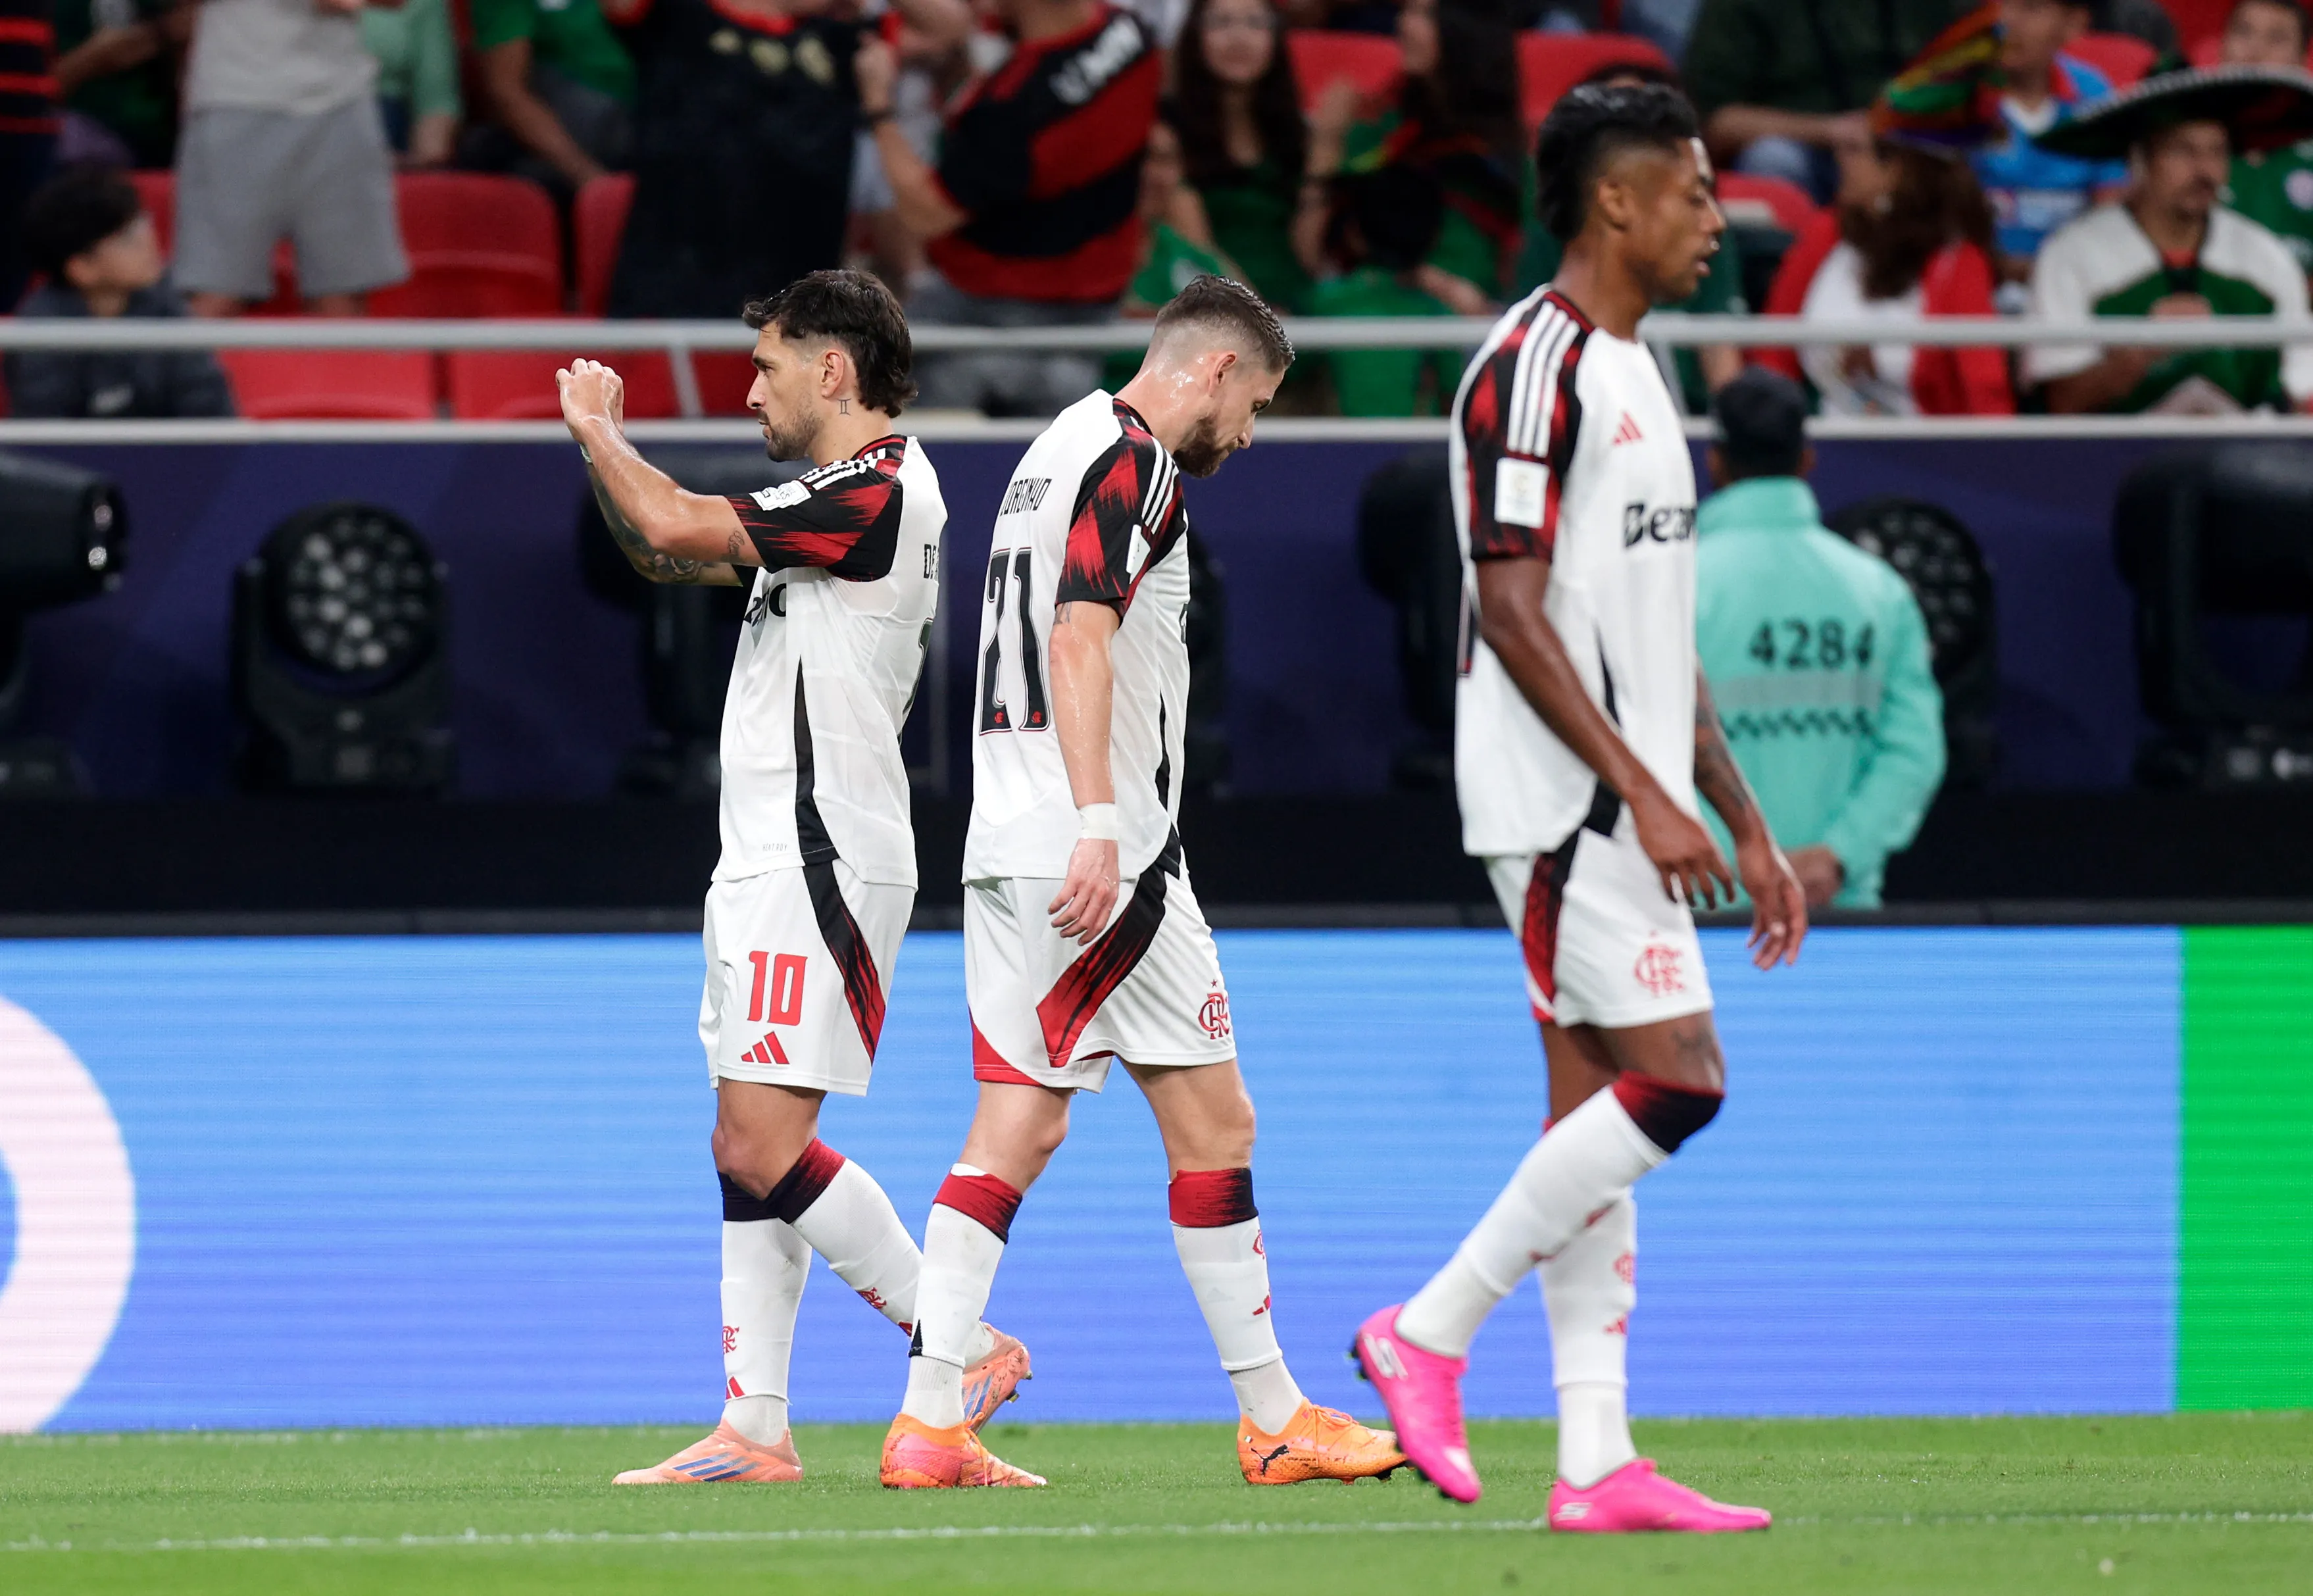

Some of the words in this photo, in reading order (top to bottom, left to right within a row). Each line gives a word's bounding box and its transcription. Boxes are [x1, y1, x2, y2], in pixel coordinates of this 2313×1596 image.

[979, 547, 1051, 736] 21
[1748, 617, 1874, 670] 4284
[747, 950, 808, 1026] 10
